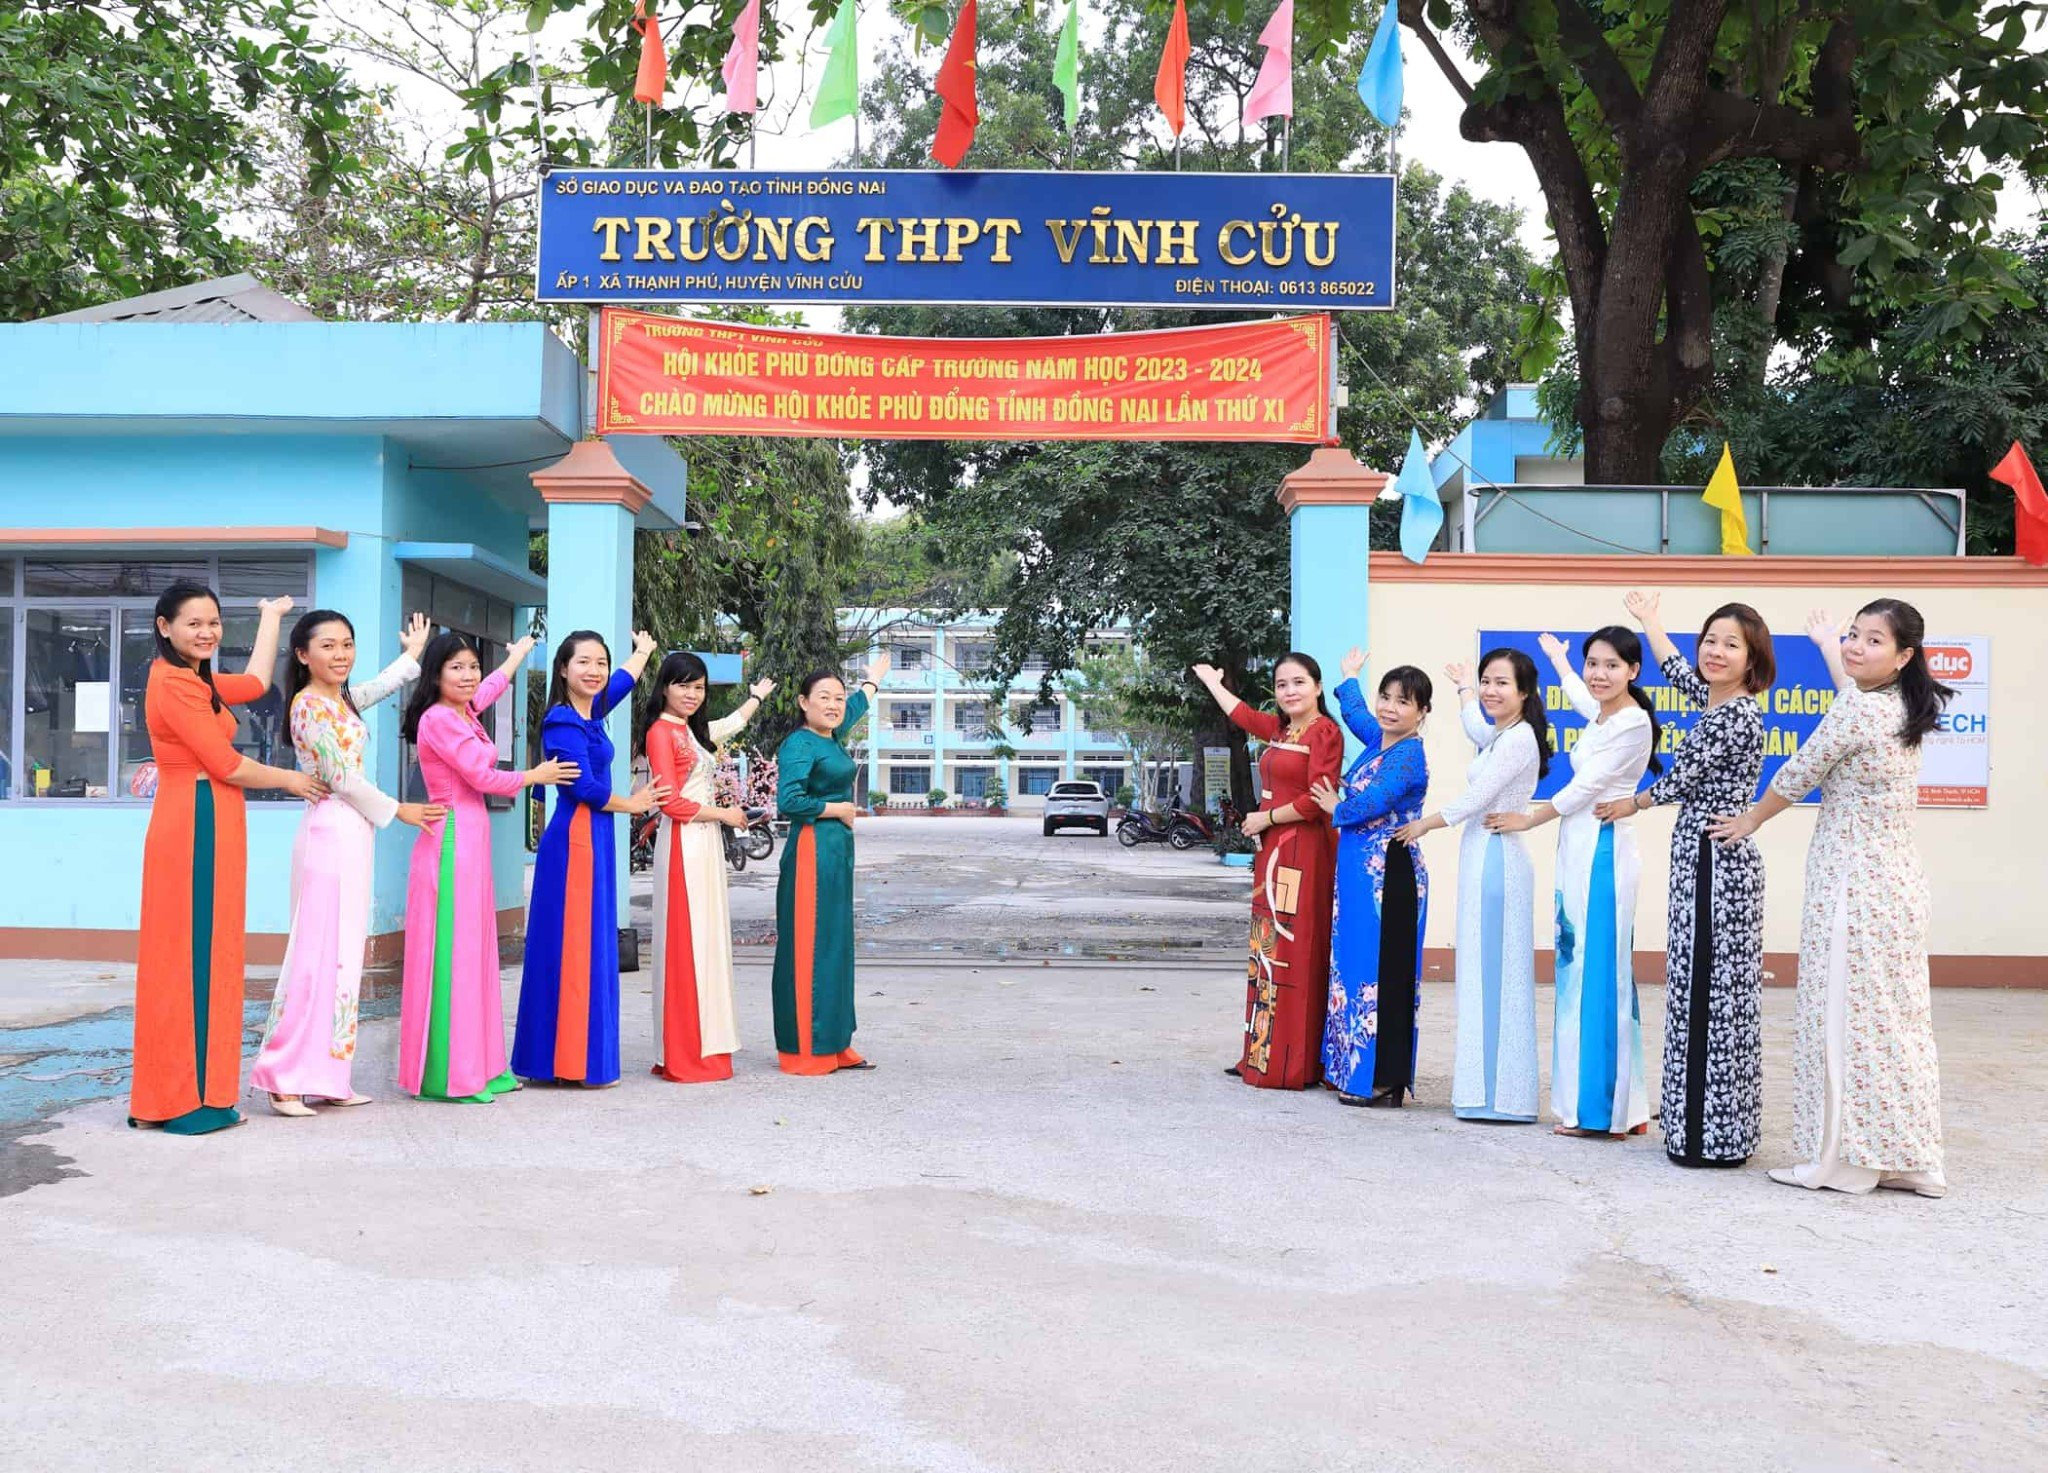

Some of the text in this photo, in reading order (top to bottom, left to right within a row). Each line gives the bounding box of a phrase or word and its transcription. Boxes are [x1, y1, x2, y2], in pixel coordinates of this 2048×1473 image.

[556, 176, 579, 194] SỞ
[582, 180, 621, 195] GIAO
[625, 181, 658, 197] DỤC
[729, 181, 762, 197] TẠO
[592, 199, 1340, 267] TRƯỜNG THPT VĨNH CỬU
[556, 270, 578, 289] ẤP
[583, 275, 590, 288] 1
[600, 273, 621, 288] XÃ
[626, 275, 680, 291] THẠNH
[726, 273, 781, 292] HUYỆN
[786, 273, 824, 289] VĨNH
[829, 270, 863, 289] CỬU
[1175, 277, 1375, 297] ĐIỆN THOẠI: 0613 865022
[709, 330, 745, 342] THPT
[663, 347, 698, 381] HỘI
[704, 344, 760, 377] KHỎE
[1025, 356, 1077, 380] NĂM
[1083, 356, 1128, 387] HỌC
[1134, 356, 1188, 382] 2023
[1208, 357, 1263, 382] 2024
[639, 387, 697, 416] CHÀO
[702, 389, 768, 419] MỪNG
[773, 389, 810, 423] HỘI
[816, 386, 872, 420] KHỎE
[878, 390, 924, 421] PHÙ
[996, 389, 1046, 422] TỈNH
[1120, 398, 1159, 423] NAI
[1165, 390, 1208, 423] LẦN
[1214, 394, 1259, 422] THỨ
[1263, 398, 1285, 423] XI
[1774, 684, 1835, 714] CÁCH
